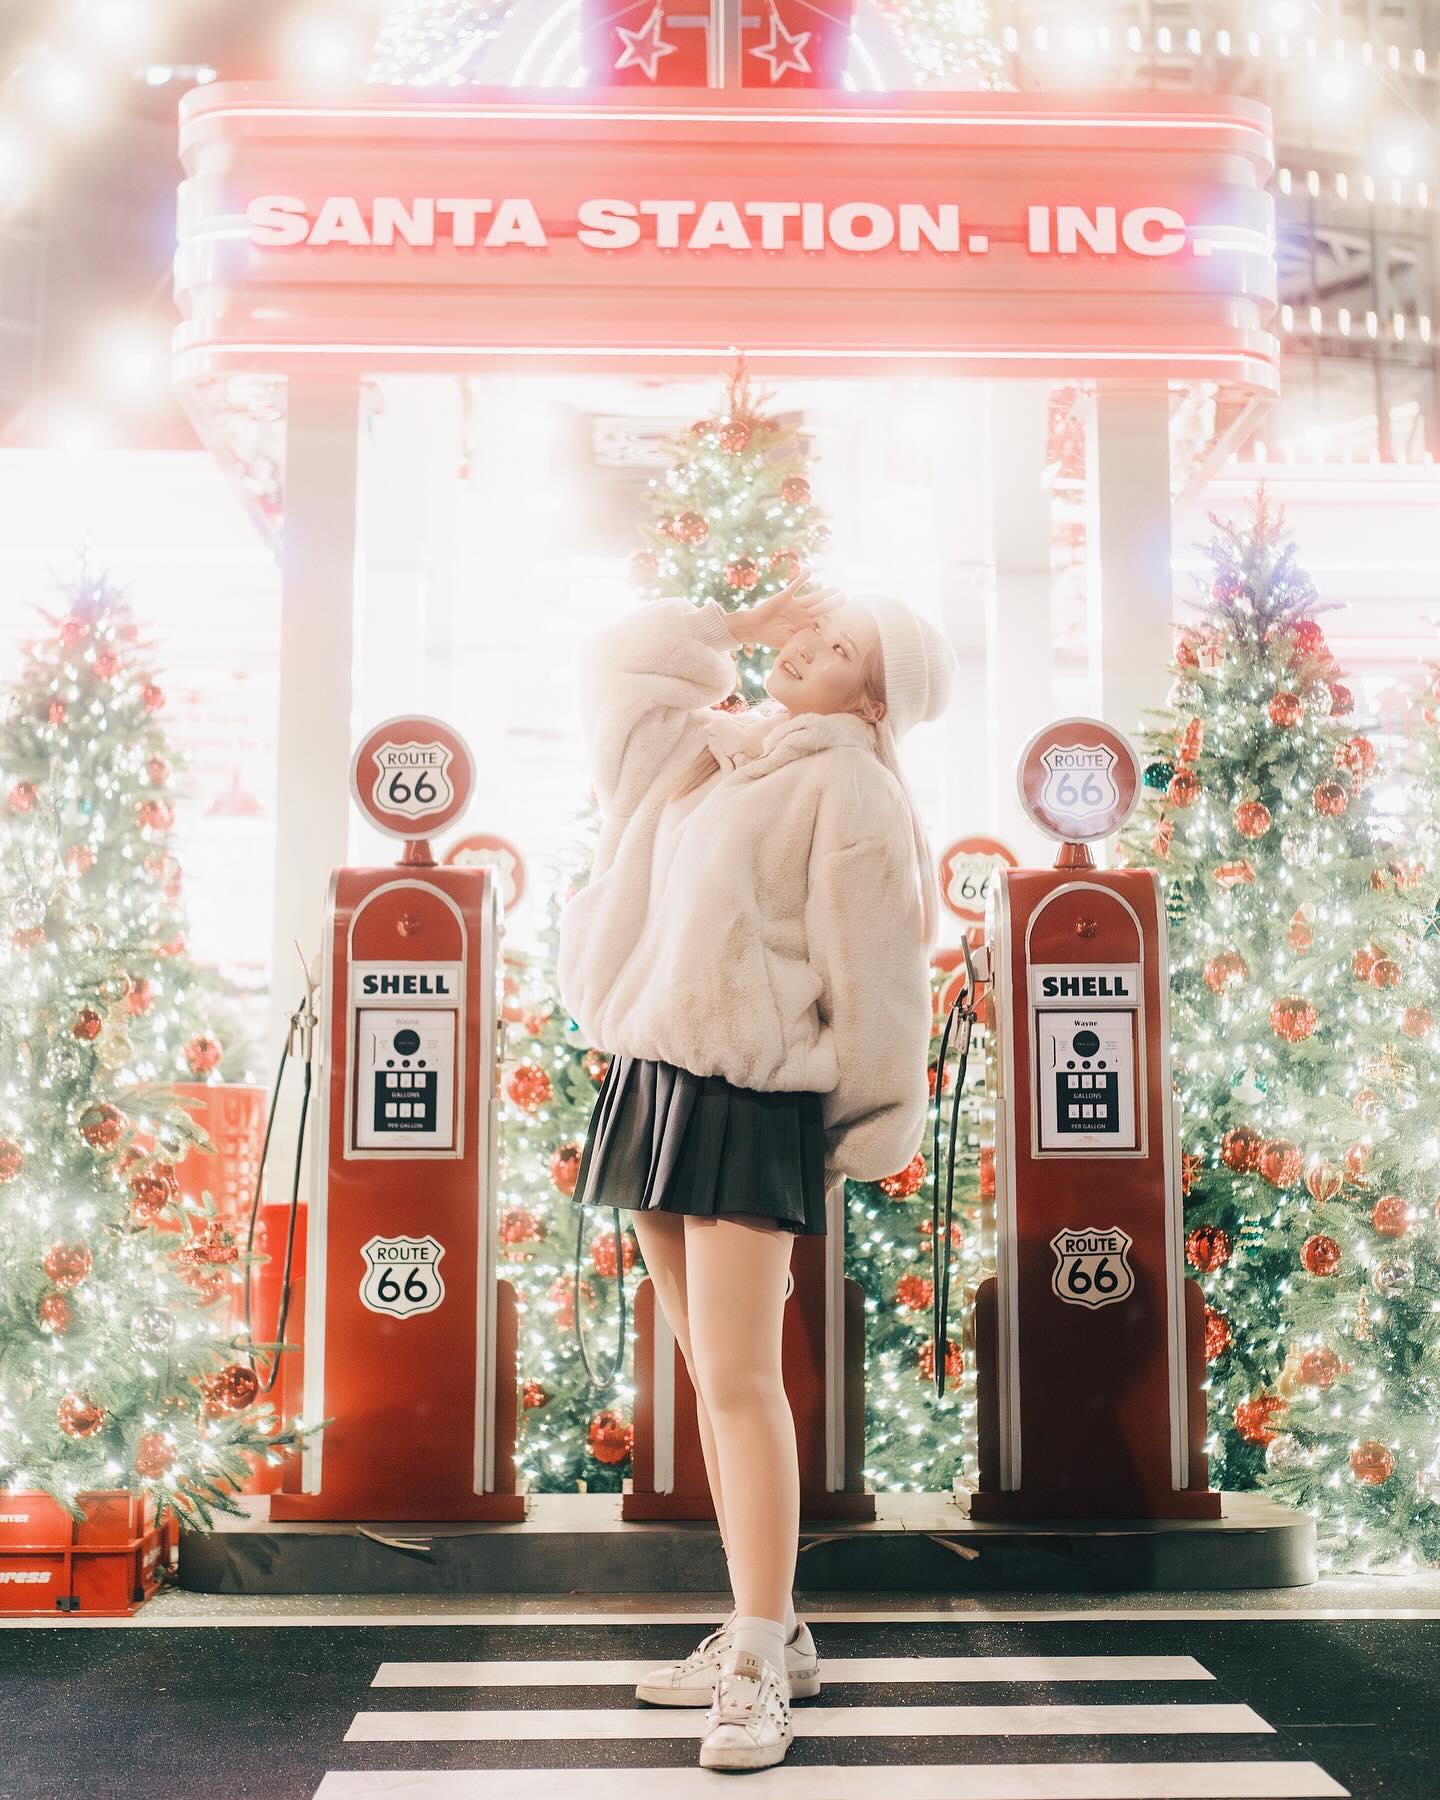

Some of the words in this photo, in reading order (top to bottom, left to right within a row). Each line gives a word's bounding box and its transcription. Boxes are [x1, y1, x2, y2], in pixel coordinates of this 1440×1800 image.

[246, 196, 548, 249] SANTA
[578, 199, 989, 253] STATION.
[1028, 205, 1213, 257] INC.
[387, 752, 438, 765] ROUTE
[1055, 754, 1104, 767] ROUTE
[388, 770, 438, 804] 66
[1056, 772, 1104, 807] 66
[362, 975, 450, 994] SHELL
[1042, 976, 1129, 997] SHELL
[377, 1247, 429, 1260] ROUTE
[1065, 1238, 1117, 1252] ROUTE
[378, 1267, 428, 1303] 66
[1067, 1257, 1119, 1295] 66
